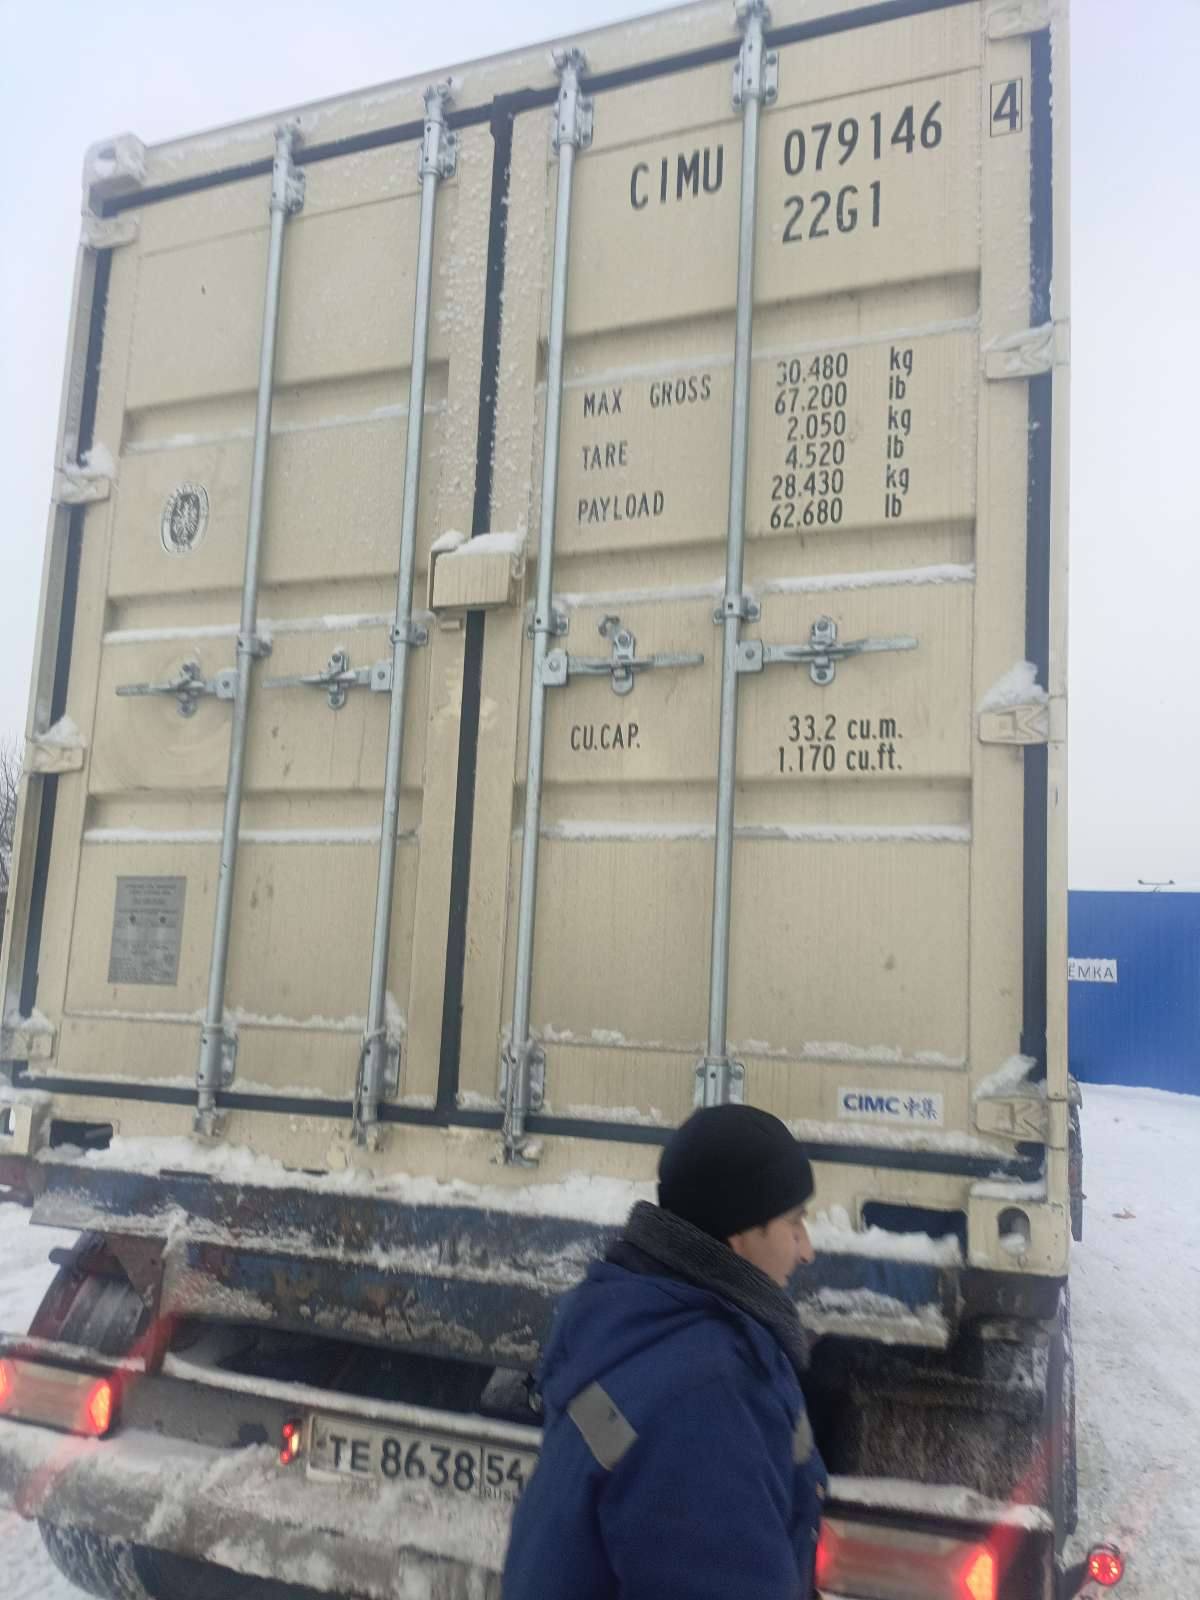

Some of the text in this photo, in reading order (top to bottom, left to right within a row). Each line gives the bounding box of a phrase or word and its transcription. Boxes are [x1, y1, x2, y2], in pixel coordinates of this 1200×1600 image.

[630, 81, 1020, 212] CIMU 079146 4
[782, 180, 881, 244] 22G1
[583, 346, 914, 418] MAX GROSS 30.480 kg
[775, 382, 848, 416] 67.200
[582, 405, 912, 470] TARE 2.050 kg
[785, 435, 905, 470] 4.520 lb
[578, 463, 910, 525] PAYLOAD 28.430 kg
[769, 493, 903, 529] 62.680 lb
[570, 714, 903, 751] CU.CAP. 33.2 cu.m.
[778, 742, 903, 773] 1.170 cu.ft.
[843, 1092, 900, 1115] CIMC
[380, 1436, 476, 1492] 8638
[485, 1454, 525, 1491] 54
